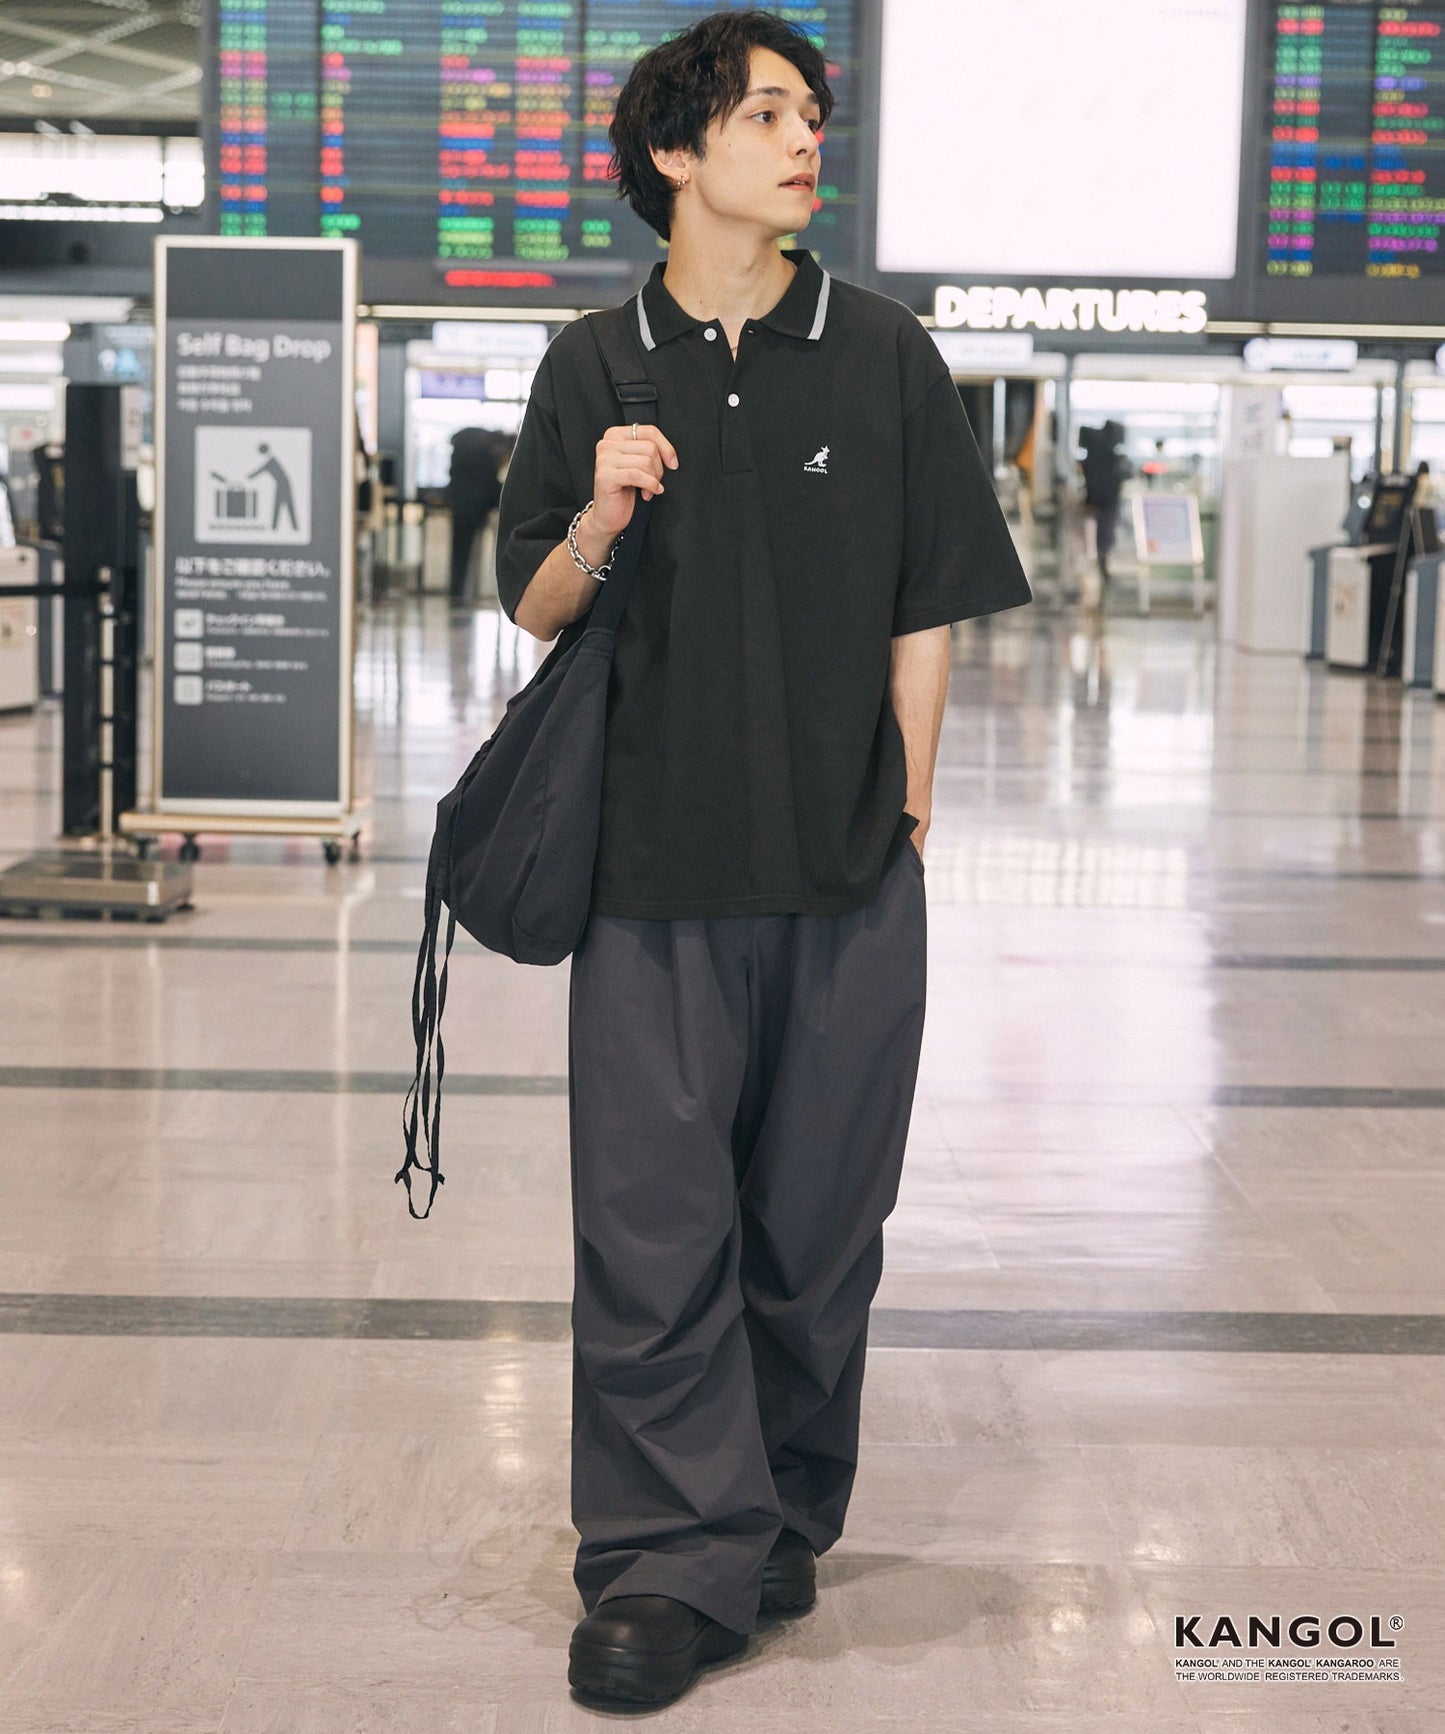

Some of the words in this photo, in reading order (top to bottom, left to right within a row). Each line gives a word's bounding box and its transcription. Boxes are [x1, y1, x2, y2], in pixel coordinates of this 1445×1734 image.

[934, 285, 1208, 333] DEPARTURES
[176, 332, 223, 357] Self
[224, 333, 270, 363] Bag
[273, 334, 332, 364] Drop
[803, 465, 828, 475] KANGOL
